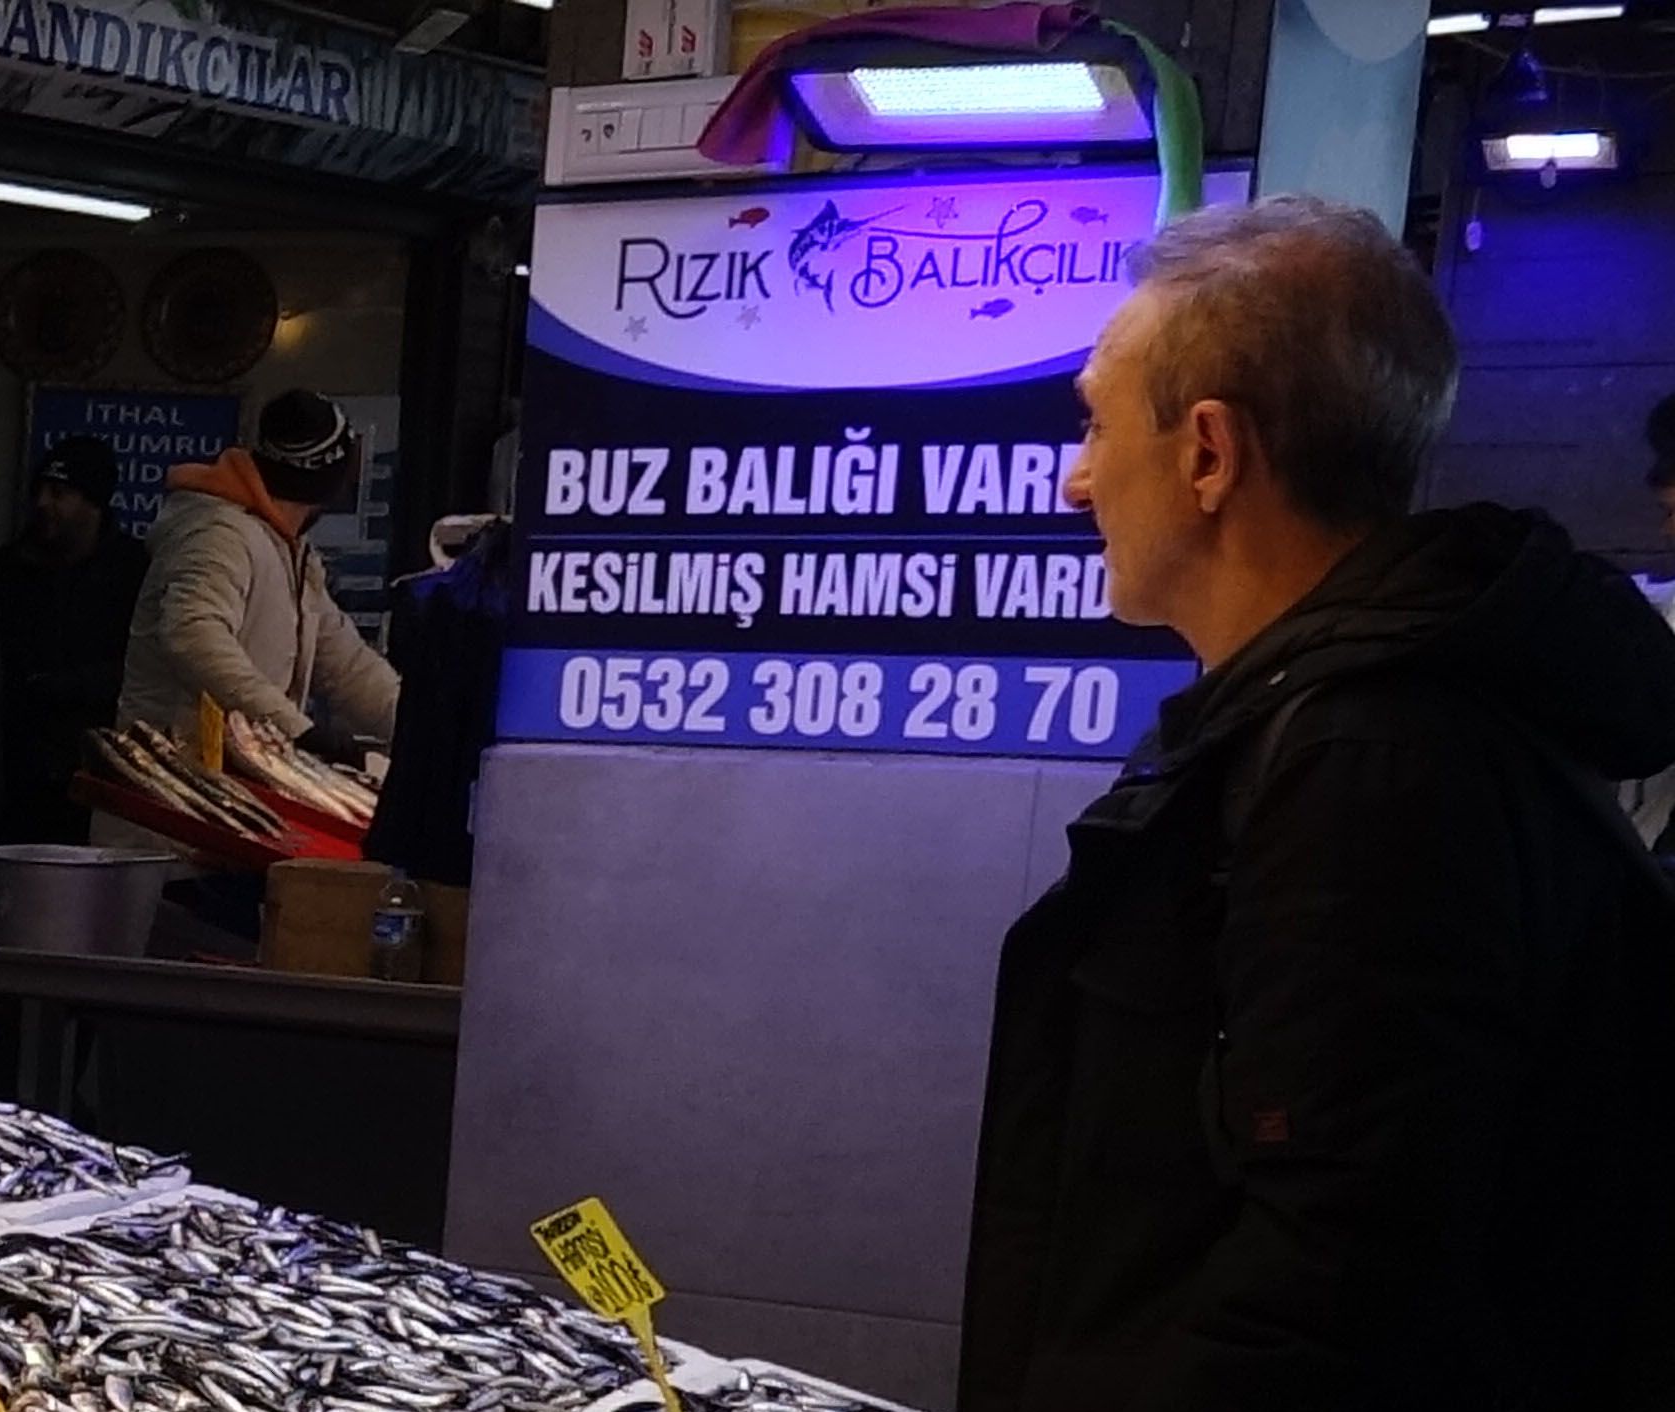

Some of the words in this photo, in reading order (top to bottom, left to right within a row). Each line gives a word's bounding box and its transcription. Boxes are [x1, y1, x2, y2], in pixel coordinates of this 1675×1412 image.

[545, 449, 665, 517] BUZ
[686, 427, 898, 516] BALIĞI
[560, 657, 728, 734] 0532
[748, 662, 882, 737] 308
[903, 666, 999, 741] 28
[1024, 667, 1119, 746] 70
